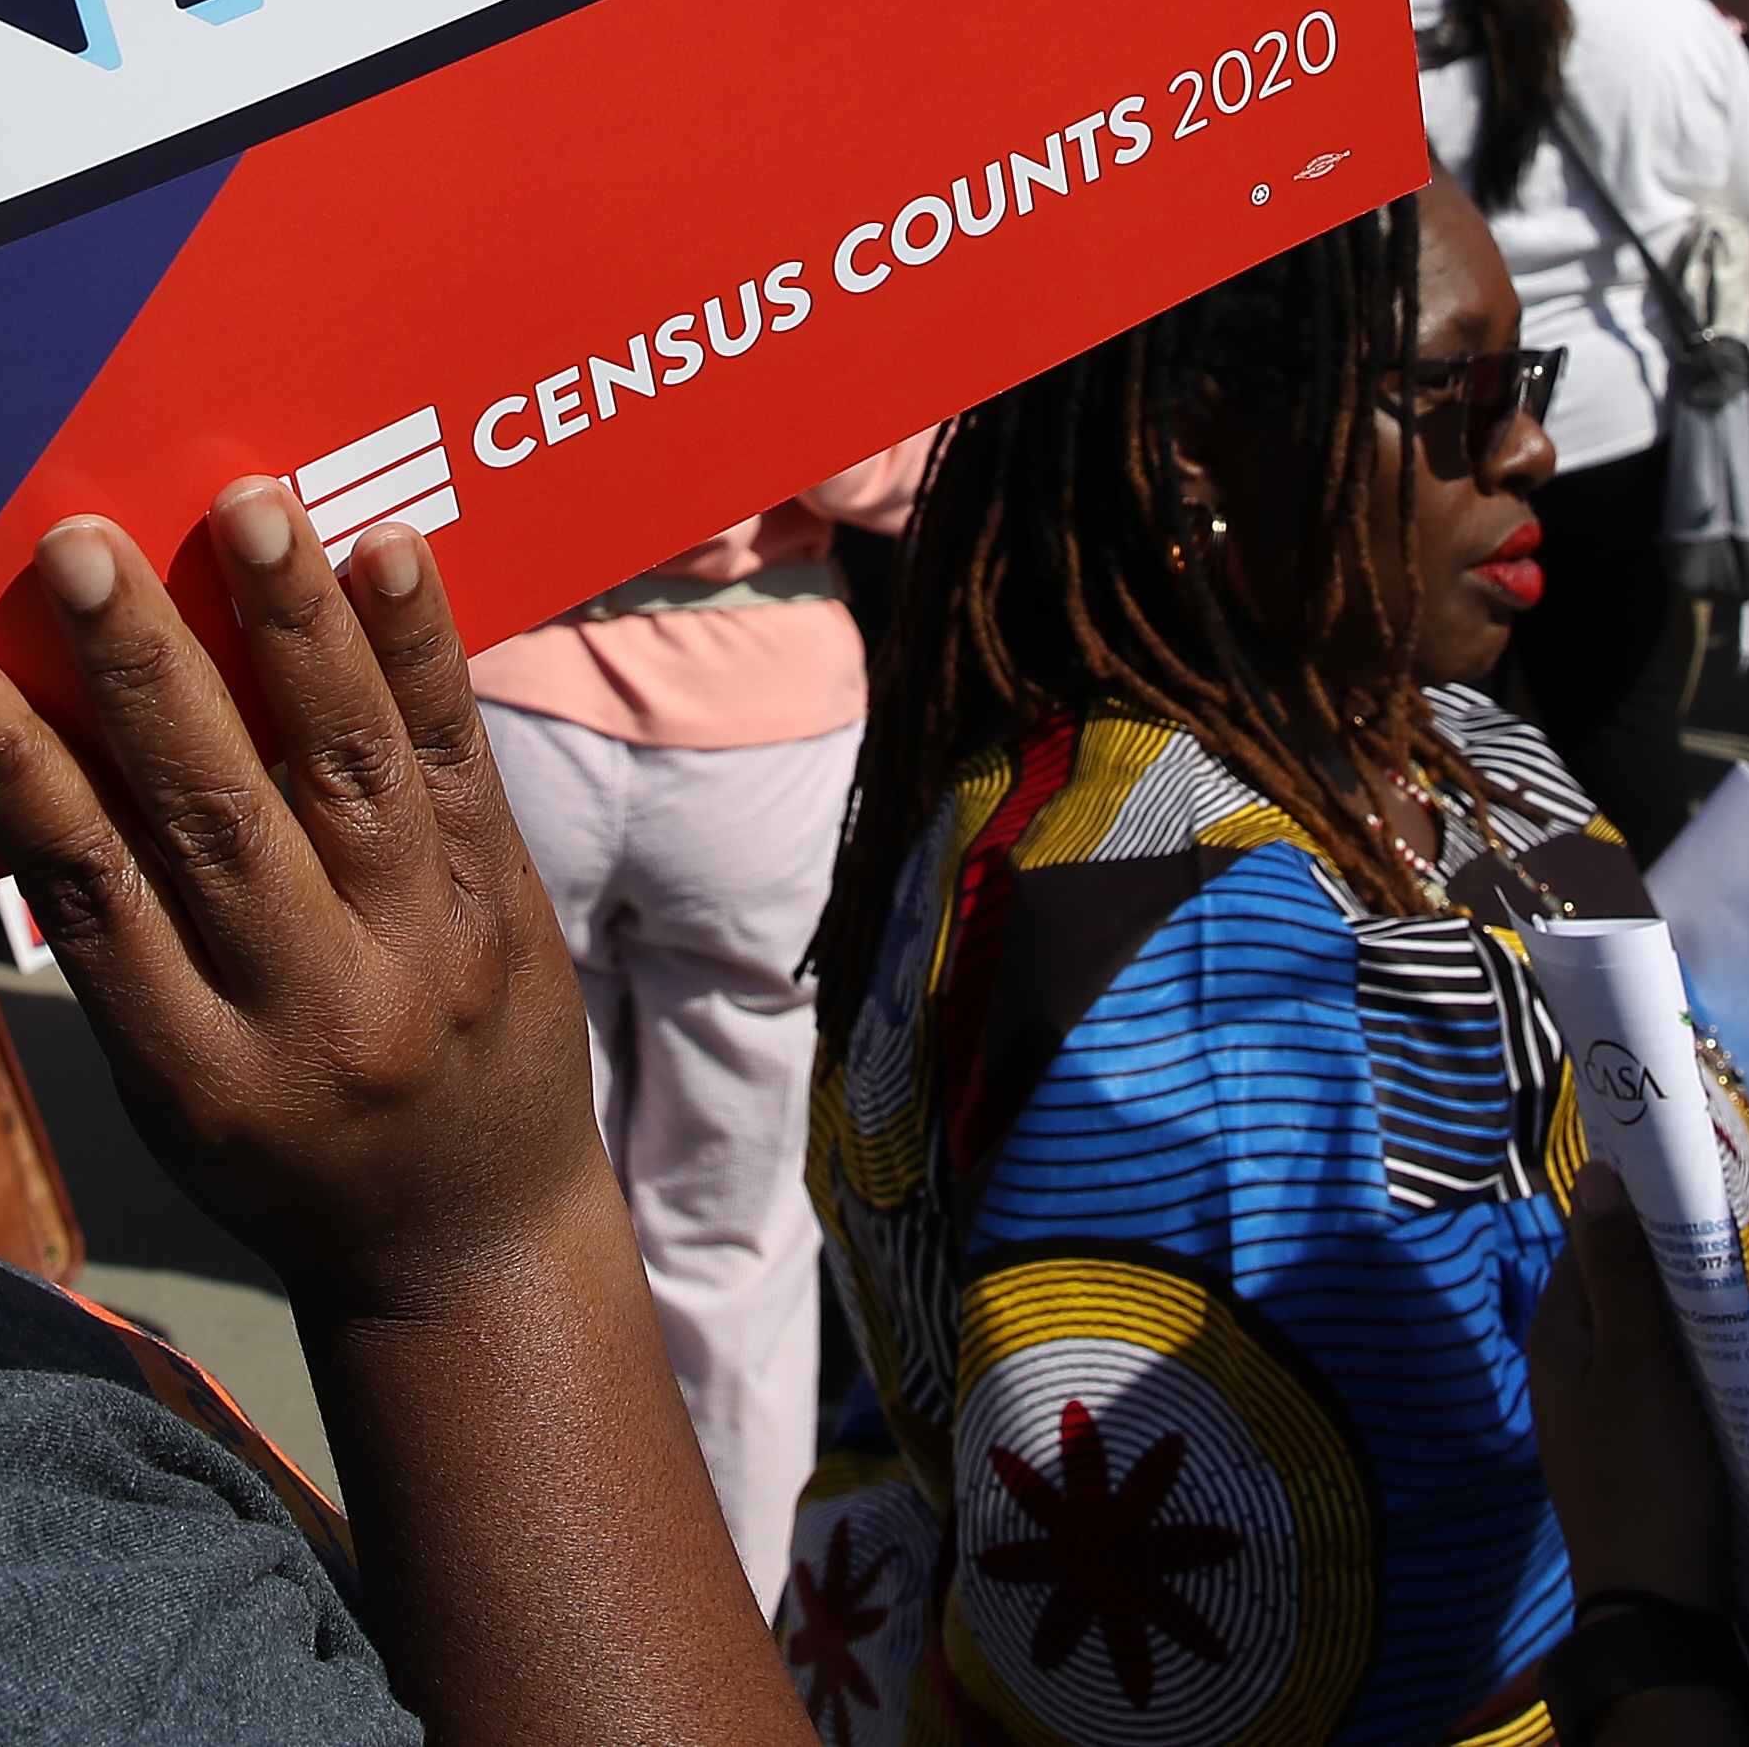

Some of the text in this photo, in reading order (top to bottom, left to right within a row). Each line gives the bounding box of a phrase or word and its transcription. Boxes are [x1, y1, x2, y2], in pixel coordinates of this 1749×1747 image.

[474, 11, 1335, 467] CENSUS COUNTS 2020
